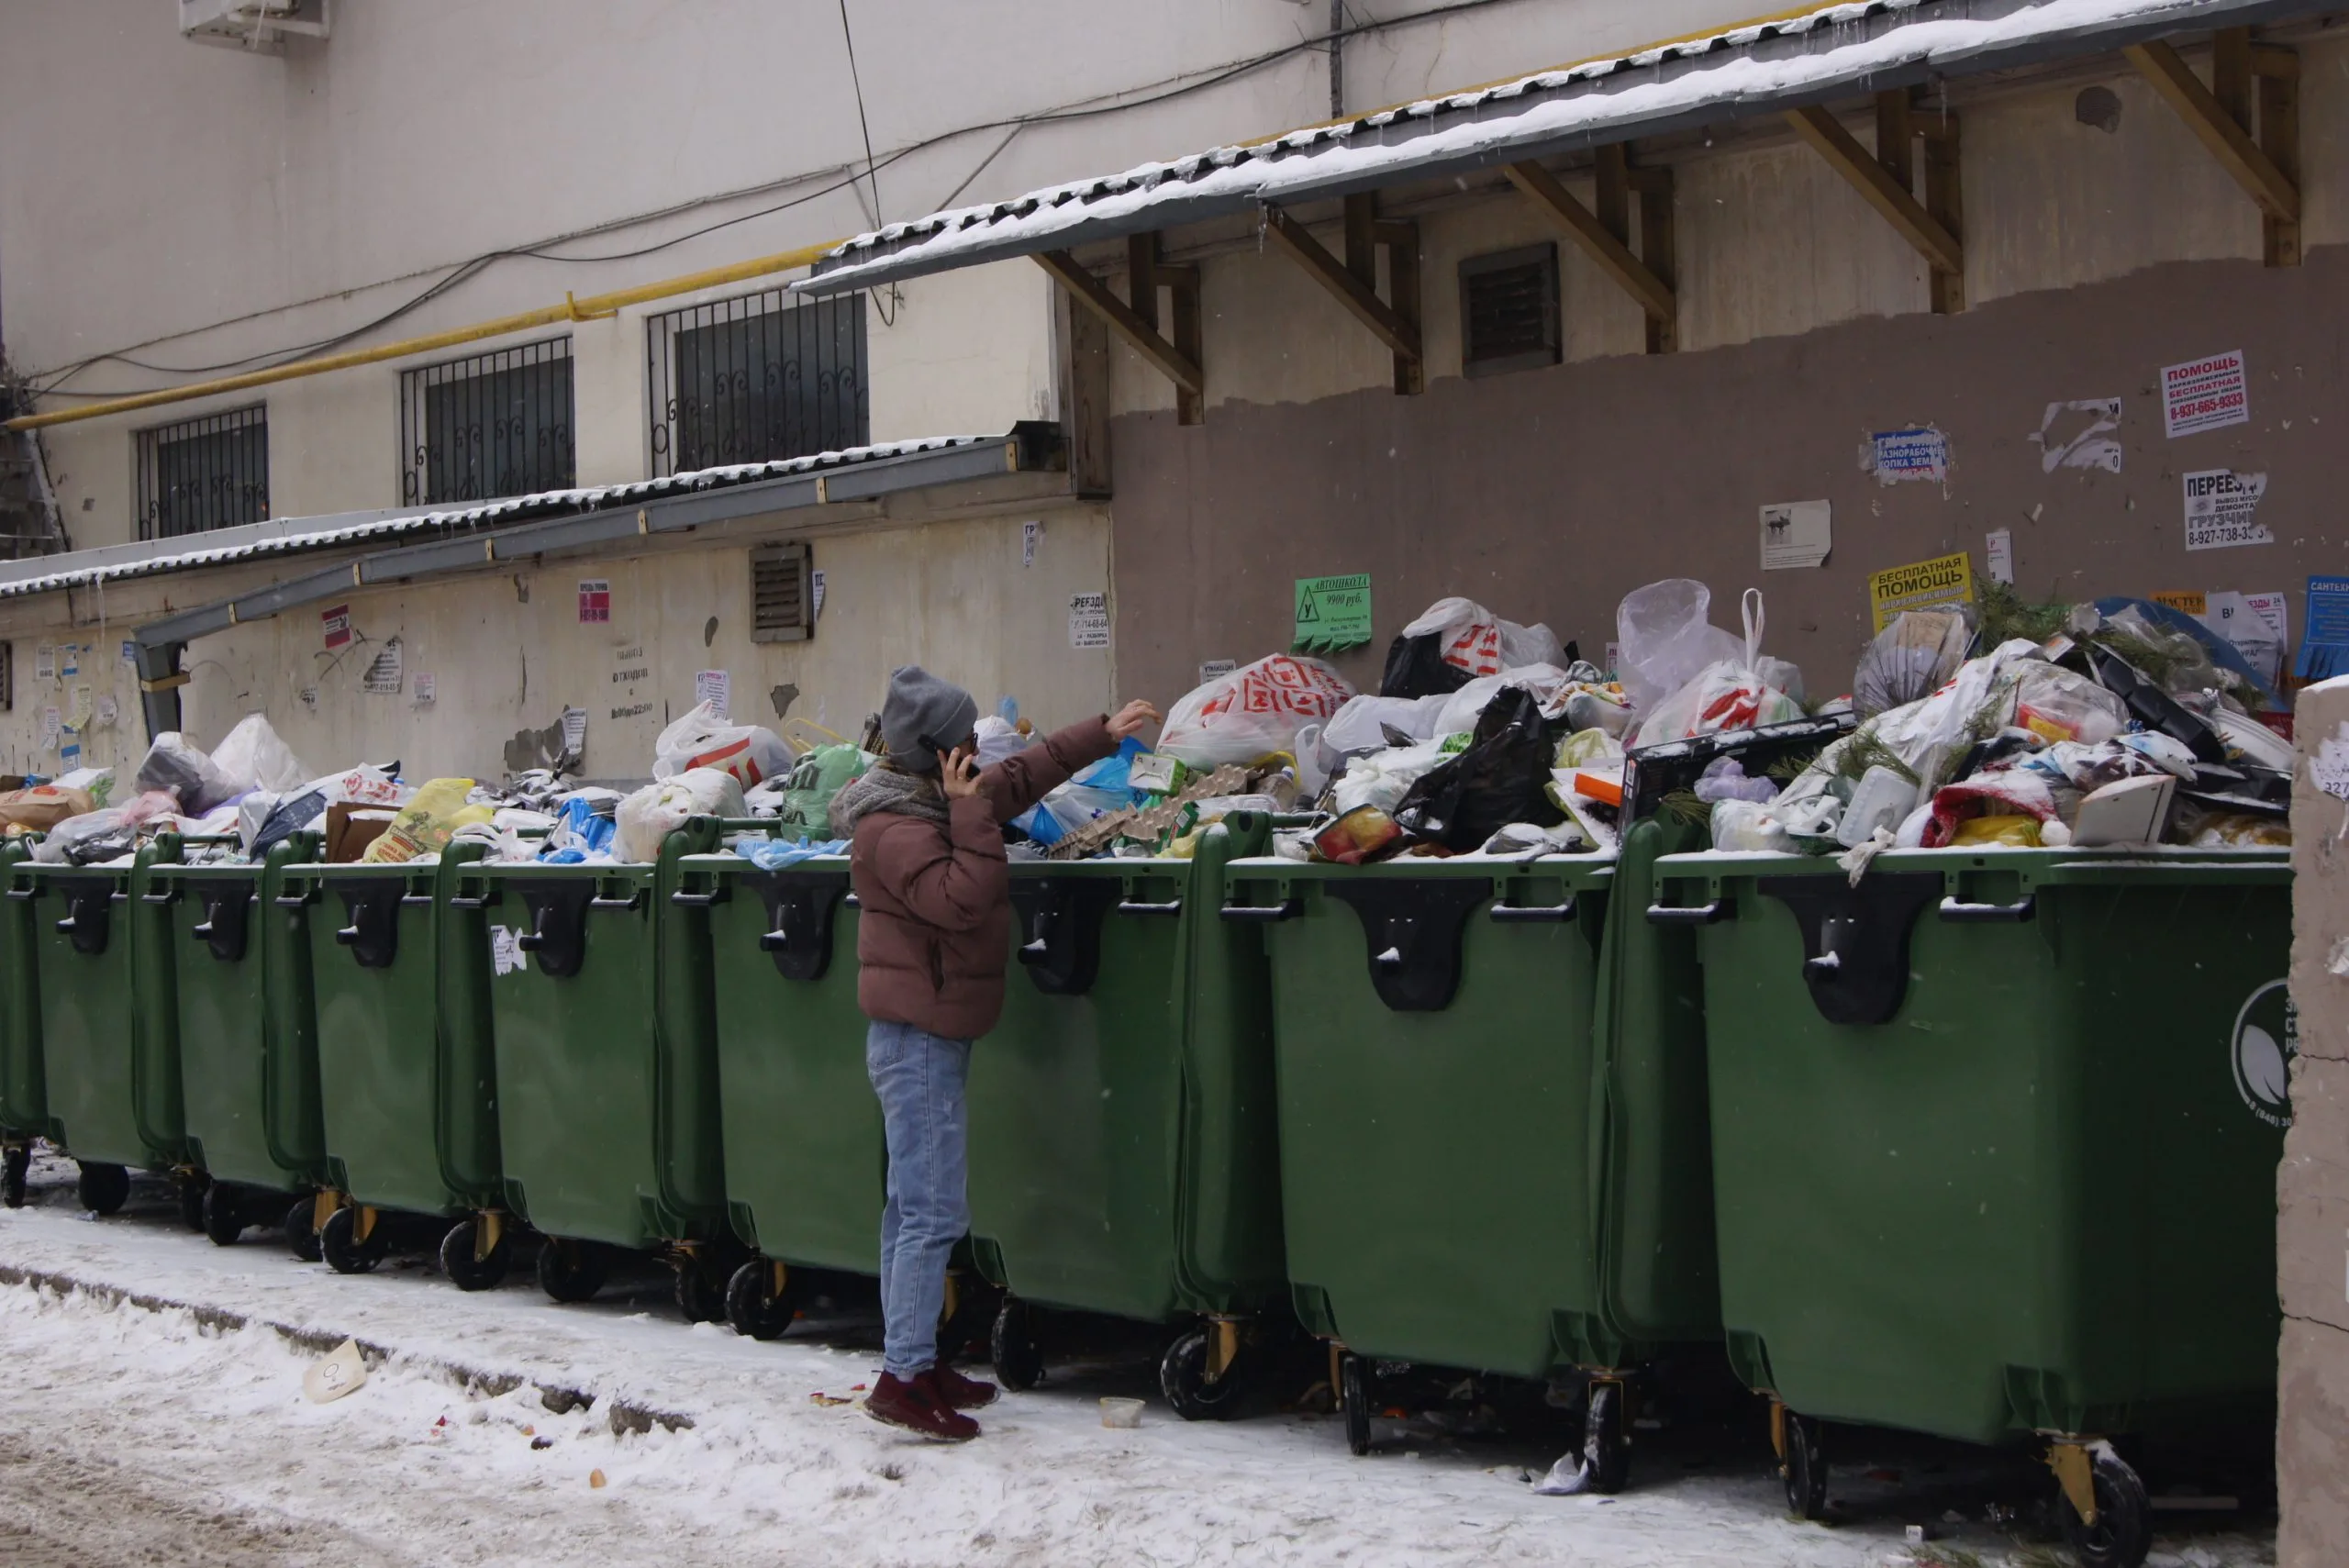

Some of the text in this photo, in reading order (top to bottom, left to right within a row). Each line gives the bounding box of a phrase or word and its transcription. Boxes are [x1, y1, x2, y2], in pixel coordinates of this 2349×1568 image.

[2167, 357, 2239, 382] ПОМОЩЬ
[2169, 375, 2241, 399] БЕСПЛАТНАЯ
[2170, 392, 2243, 420] 8-937-665-9333
[1315, 576, 1367, 590] АВТОШКОЛА
[1878, 557, 1961, 584] БЕСПЛАТНАЯ
[1877, 570, 1963, 598] ПОМОЩЬ
[1327, 594, 1345, 605] 9900
